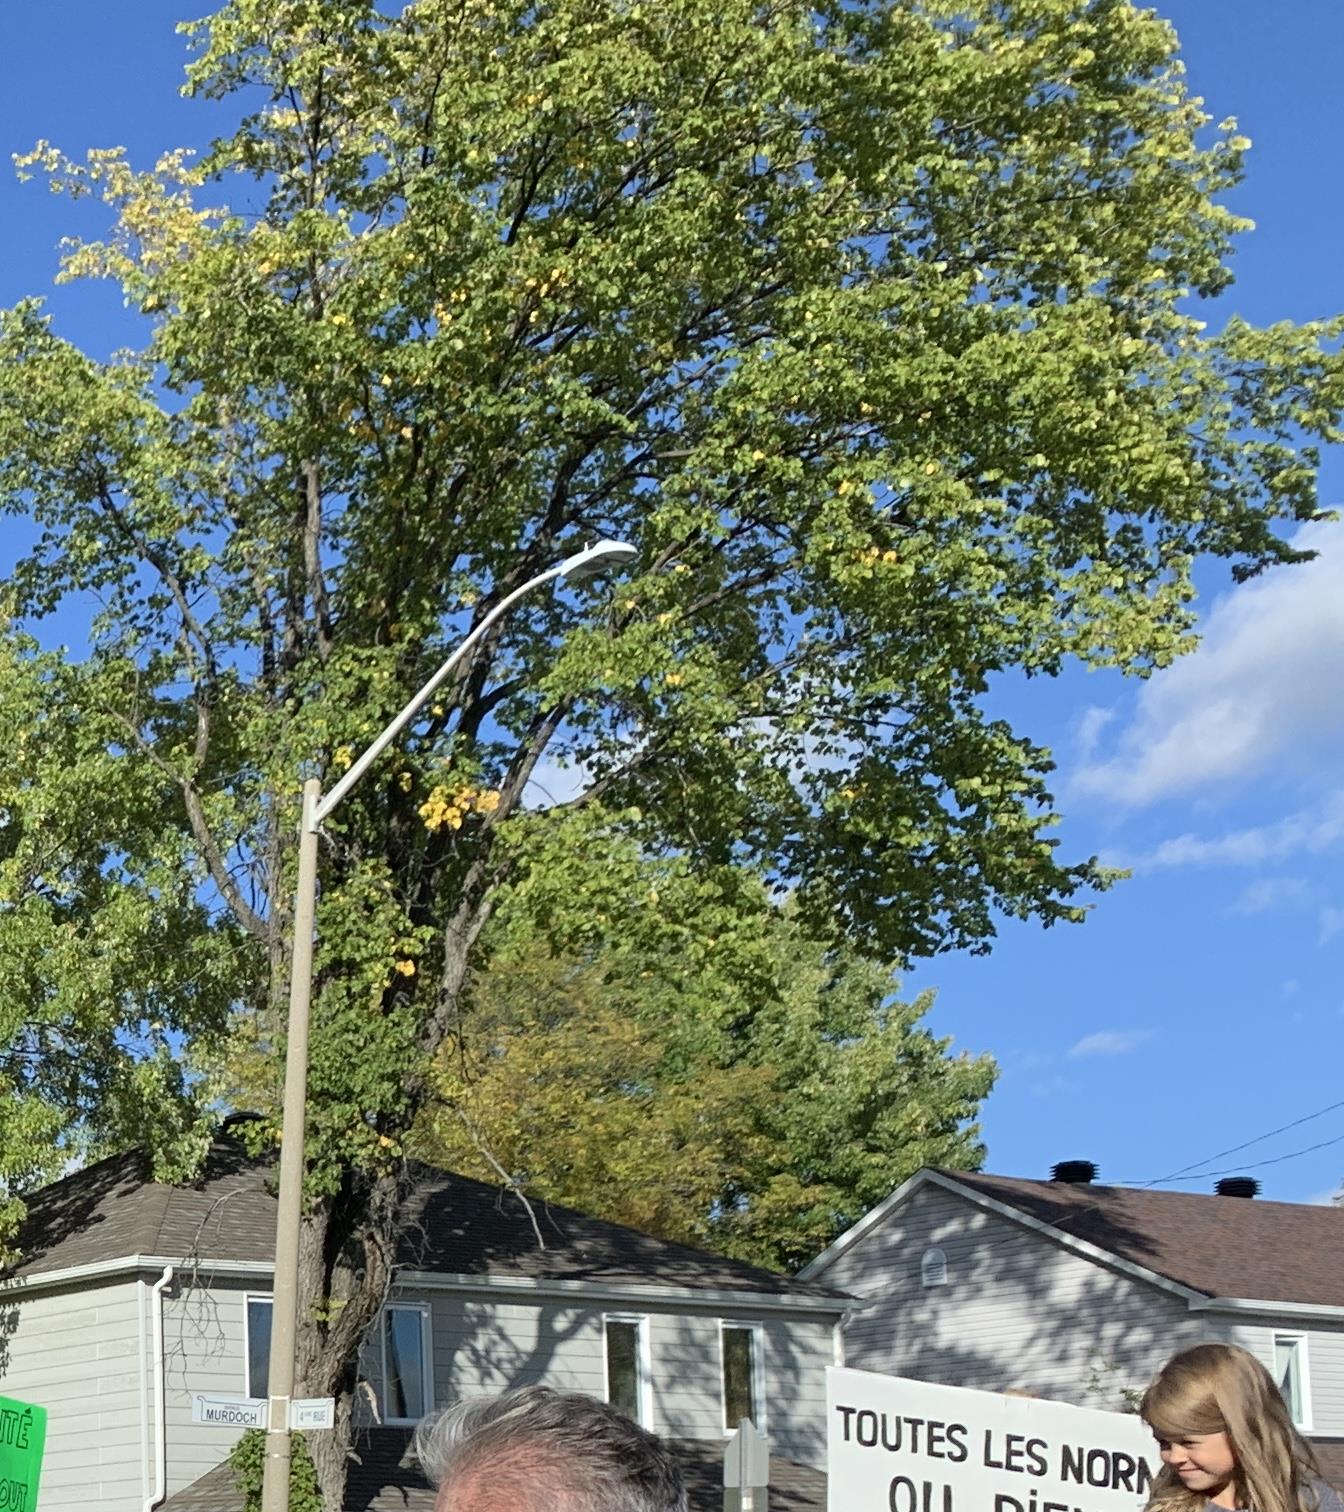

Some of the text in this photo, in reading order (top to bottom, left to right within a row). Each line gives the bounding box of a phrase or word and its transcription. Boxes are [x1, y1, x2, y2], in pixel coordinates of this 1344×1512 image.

[205, 1408, 257, 1424] MURDOCH
[835, 1405, 968, 1463] TOUTES
[983, 1429, 1049, 1477] LES
